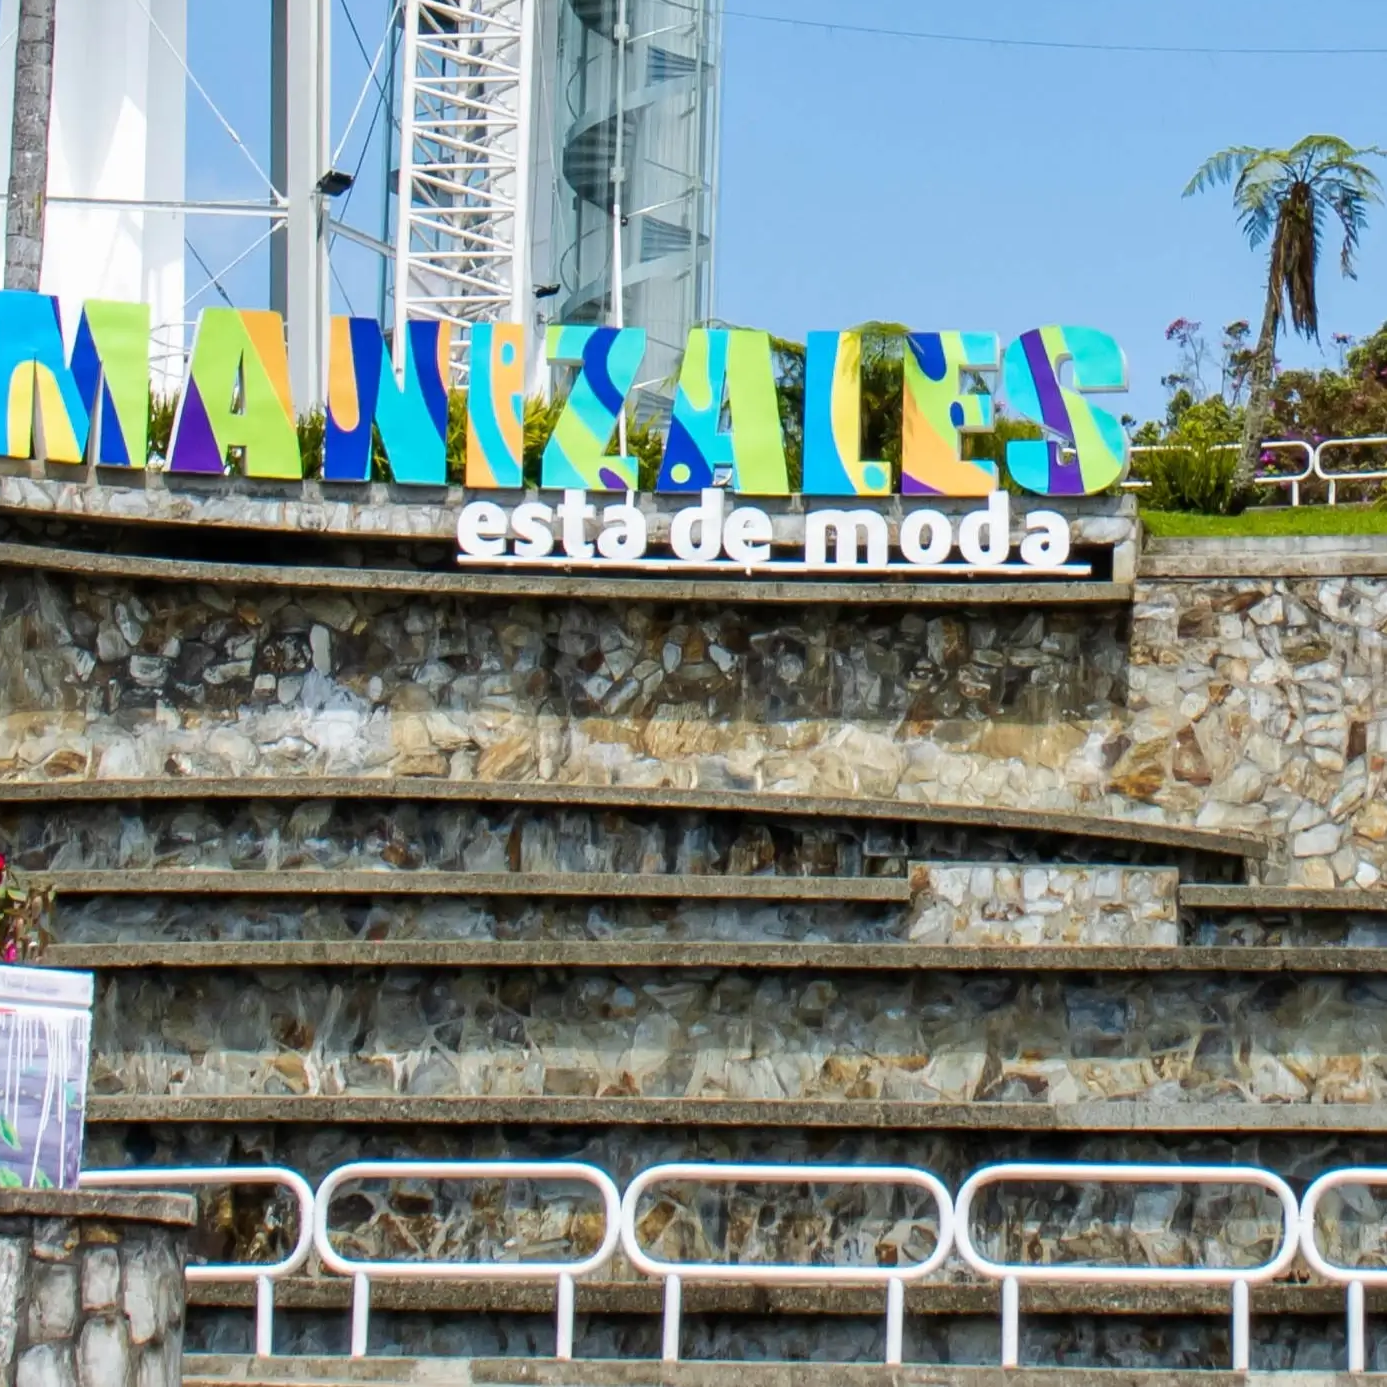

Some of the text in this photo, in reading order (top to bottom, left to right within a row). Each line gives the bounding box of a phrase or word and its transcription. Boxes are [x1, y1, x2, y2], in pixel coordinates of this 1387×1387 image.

[457, 487, 1071, 568] está de moda
